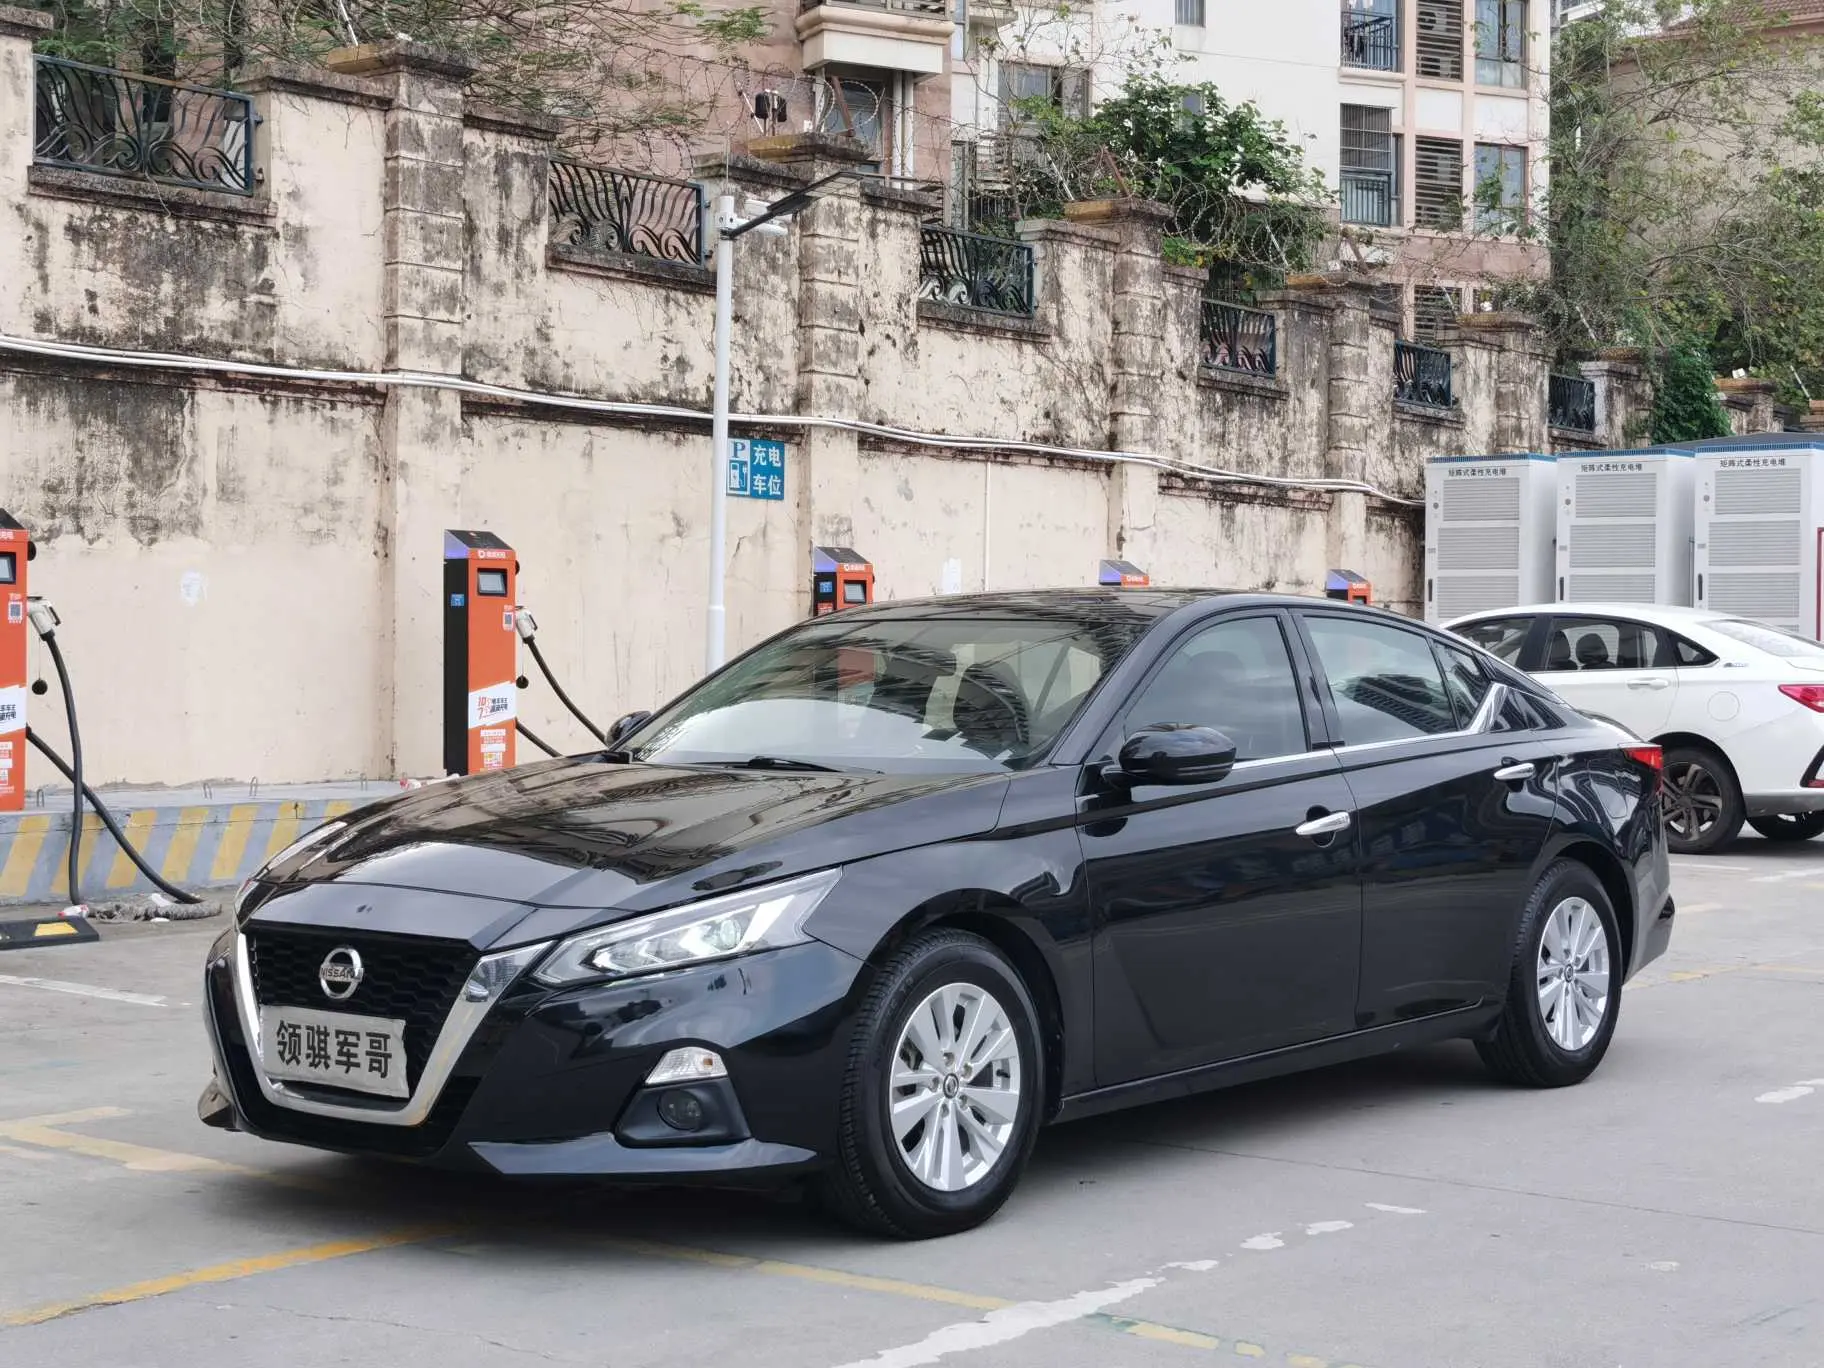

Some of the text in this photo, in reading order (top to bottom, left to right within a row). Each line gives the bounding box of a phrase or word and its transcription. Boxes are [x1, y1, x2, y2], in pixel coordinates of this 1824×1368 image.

[732, 441, 746, 459] P
[753, 444, 782, 467] 充电
[753, 474, 782, 496] 车位
[321, 966, 356, 978] NISSAN
[276, 1019, 392, 1079] 领骐军哥
